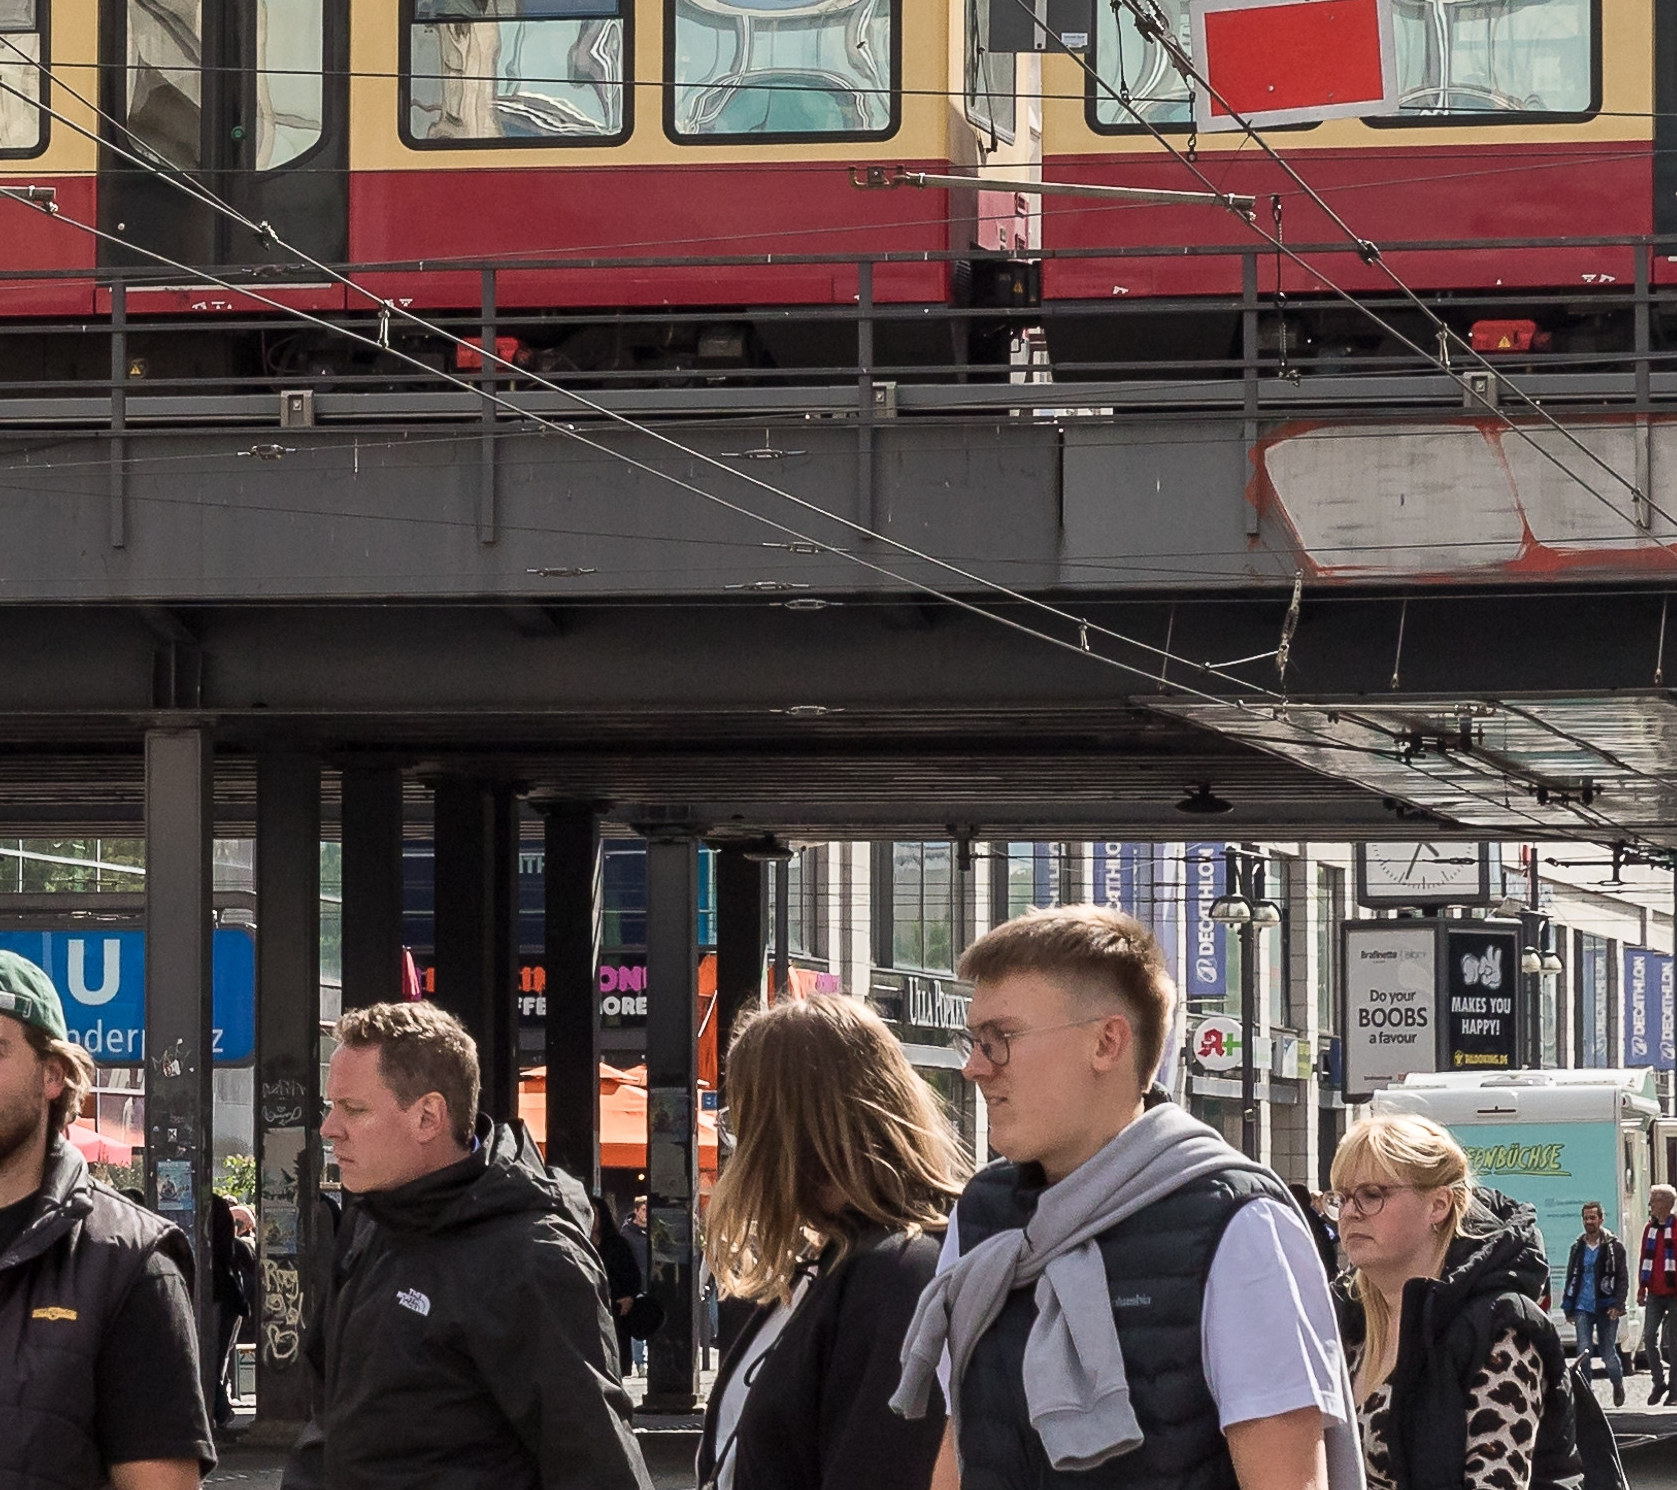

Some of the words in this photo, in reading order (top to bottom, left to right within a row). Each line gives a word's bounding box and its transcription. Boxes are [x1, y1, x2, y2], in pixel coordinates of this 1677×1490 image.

[1197, 848, 1216, 957] DECATHLON
[68, 939, 121, 1006] U
[599, 996, 648, 1016] ORE
[1369, 989, 1389, 1003] Do
[1389, 990, 1417, 1005] your
[1451, 996, 1487, 1014] MAKES
[1489, 997, 1512, 1014] YOU
[1633, 956, 1647, 1042] DECATHLON
[1661, 962, 1675, 1048] DECATHLON
[1358, 1007, 1429, 1028] BOOBS
[1461, 1018, 1501, 1036] HAPPY!
[1368, 1033, 1377, 1044] a
[1378, 1030, 1418, 1044] favour
